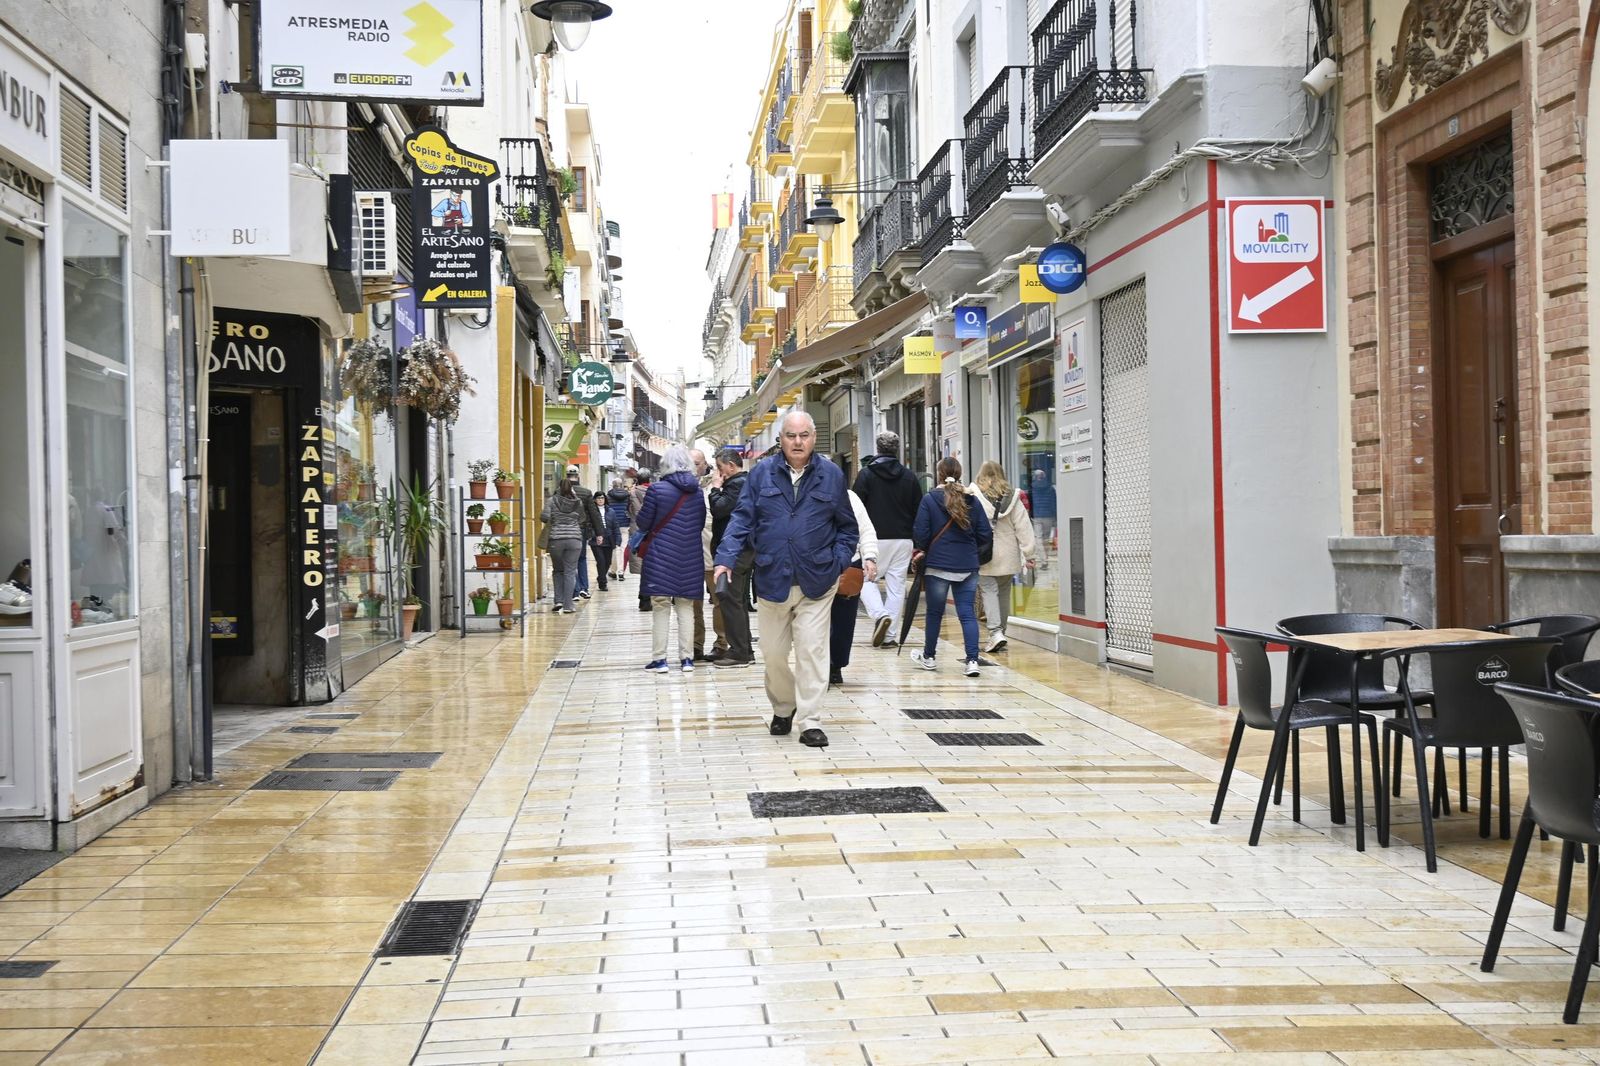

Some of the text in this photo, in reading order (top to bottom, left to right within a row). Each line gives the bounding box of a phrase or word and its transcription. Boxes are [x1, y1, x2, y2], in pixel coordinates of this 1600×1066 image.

[288, 16, 389, 30] ATRESMEDIA
[348, 31, 390, 43] RADIO
[410, 142, 488, 171] Copias de llaves
[421, 178, 480, 186] ZAPATERO
[421, 235, 484, 248] ARTESANO
[1242, 243, 1309, 253] MOVILCITY
[430, 252, 453, 260] Arreglo
[1038, 263, 1083, 274] DIGI
[465, 271, 478, 279] piel
[447, 290, 457, 298] EN
[301, 425, 323, 587] ZAPATERO
[1478, 670, 1508, 679] BARCO
